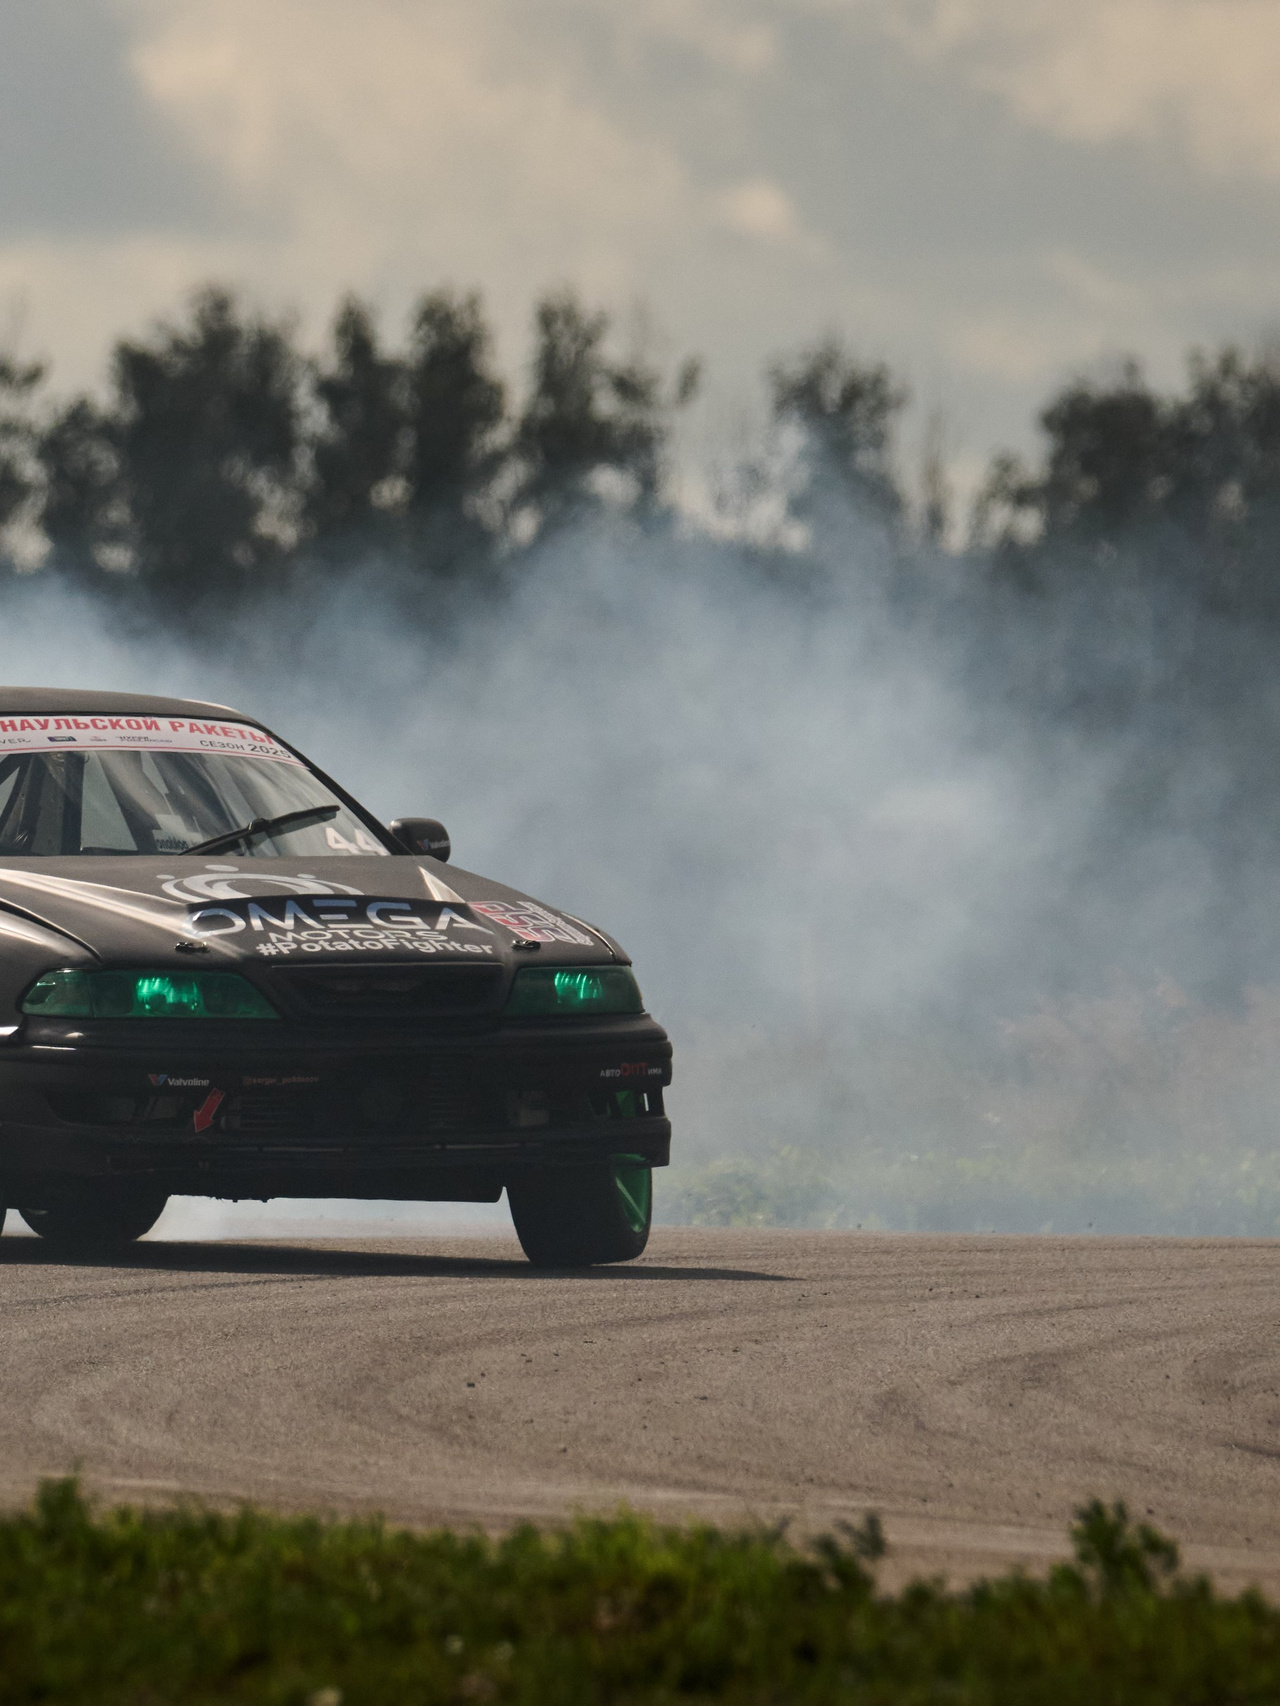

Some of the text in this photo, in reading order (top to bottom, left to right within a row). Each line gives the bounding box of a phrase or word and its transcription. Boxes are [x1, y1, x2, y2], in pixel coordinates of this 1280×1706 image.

[168, 720, 274, 745] РАКЕТЫ
[200, 739, 292, 759] СЕЗОН 2025
[184, 899, 495, 937] OMEGA
[268, 929, 448, 944] MOTORS
[256, 937, 494, 956] #PotatoFighter
[167, 1077, 210, 1087] Valvoline
